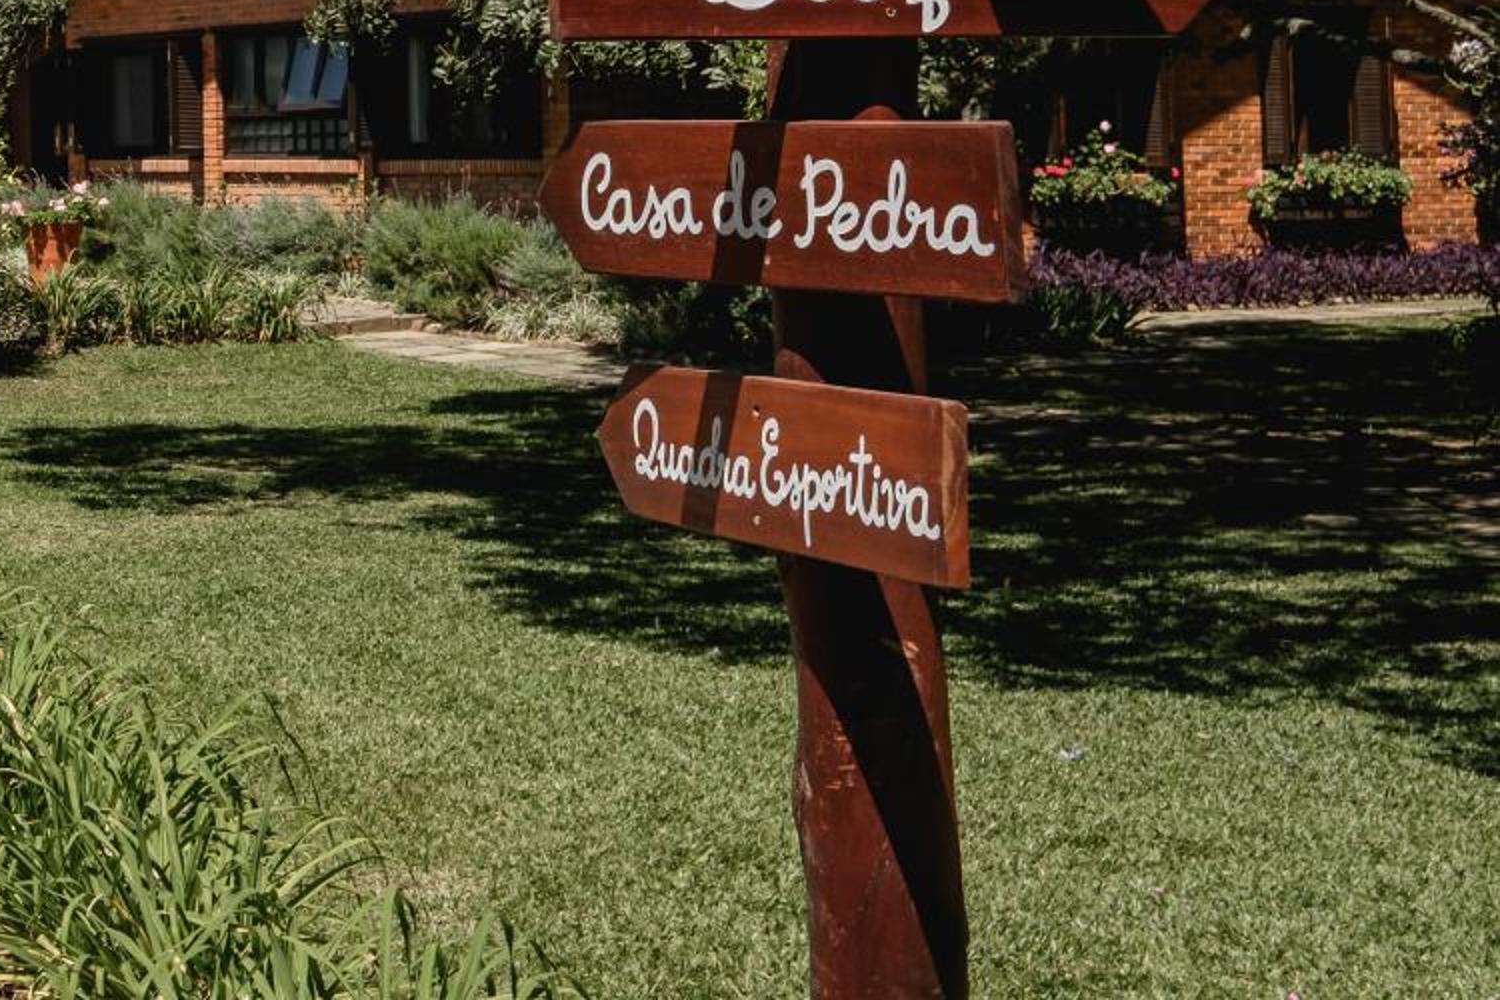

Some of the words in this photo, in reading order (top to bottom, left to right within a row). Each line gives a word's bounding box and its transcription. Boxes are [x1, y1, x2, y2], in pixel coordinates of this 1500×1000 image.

[581, 152, 703, 239] Casa
[713, 150, 783, 239] de
[794, 154, 995, 257] Pedra
[632, 397, 757, 499] Quadra
[759, 417, 941, 548] Esportiva
